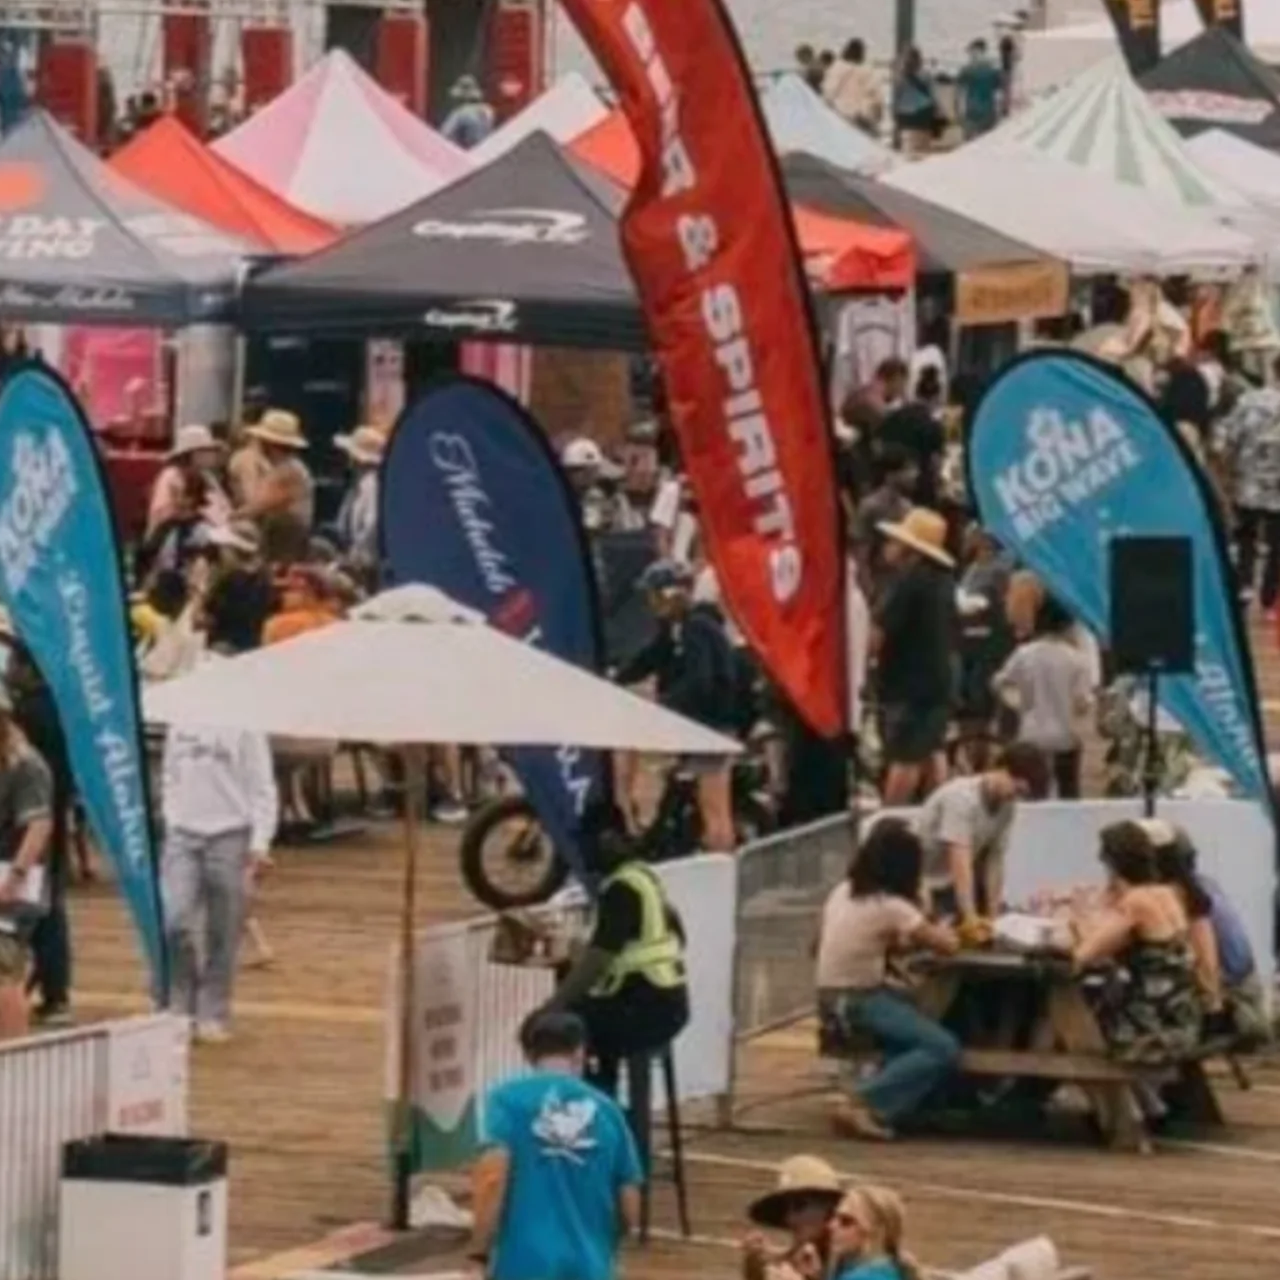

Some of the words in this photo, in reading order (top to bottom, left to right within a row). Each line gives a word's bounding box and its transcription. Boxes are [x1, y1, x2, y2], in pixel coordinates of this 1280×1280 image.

[676, 213, 719, 272] &
[701, 283, 803, 602] SPIRITS
[992, 405, 1124, 514] KONA
